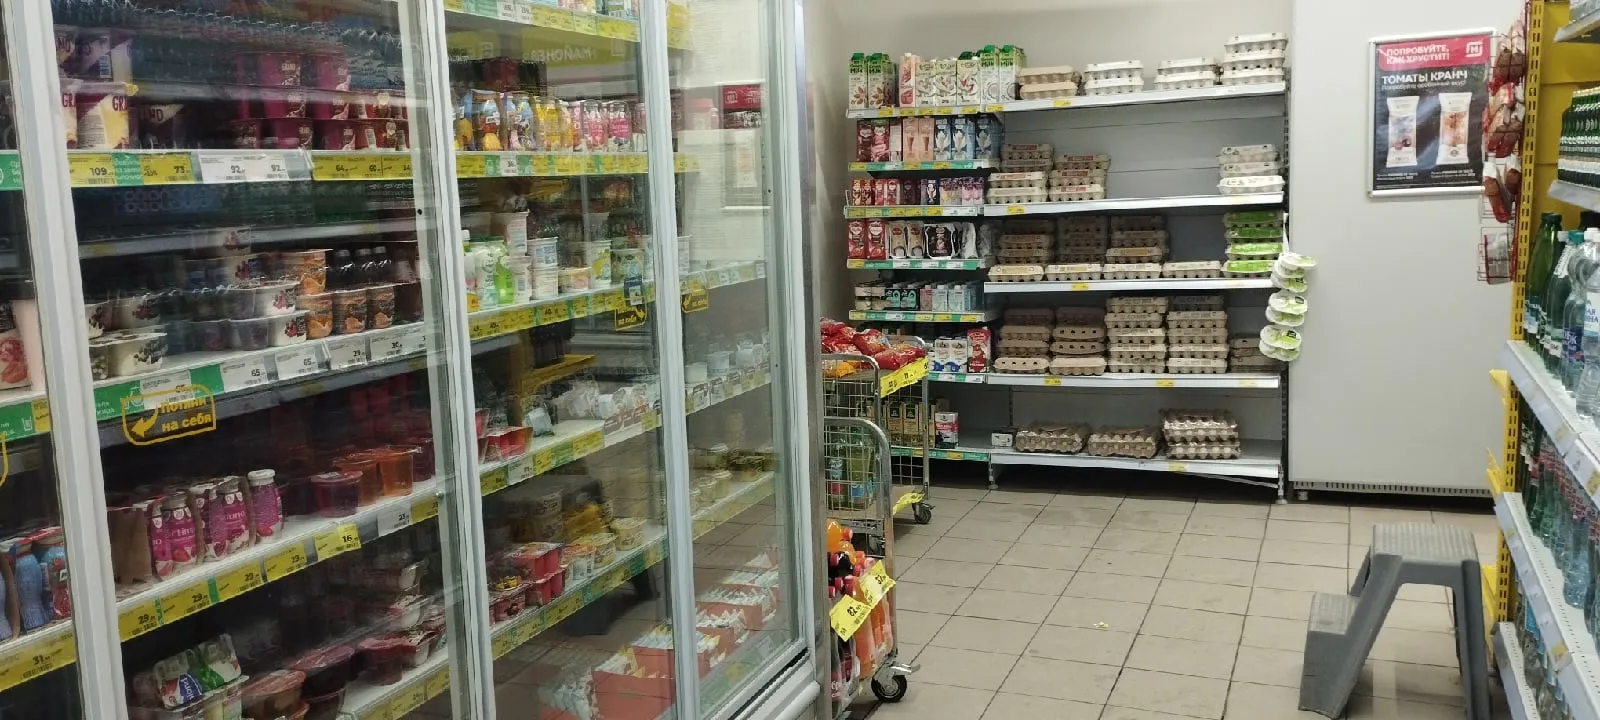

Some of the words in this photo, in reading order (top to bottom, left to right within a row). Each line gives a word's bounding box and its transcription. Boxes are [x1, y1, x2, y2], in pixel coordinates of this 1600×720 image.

[1387, 44, 1449, 56] ПОПРОБУЙТЕ,
[1387, 55, 1405, 64] КАК
[1382, 73, 1428, 85] ТОМАТЫ
[1430, 70, 1468, 81] КРАНЧ
[90, 167, 107, 176] 109
[162, 420, 179, 432] на
[182, 413, 212, 428] себя
